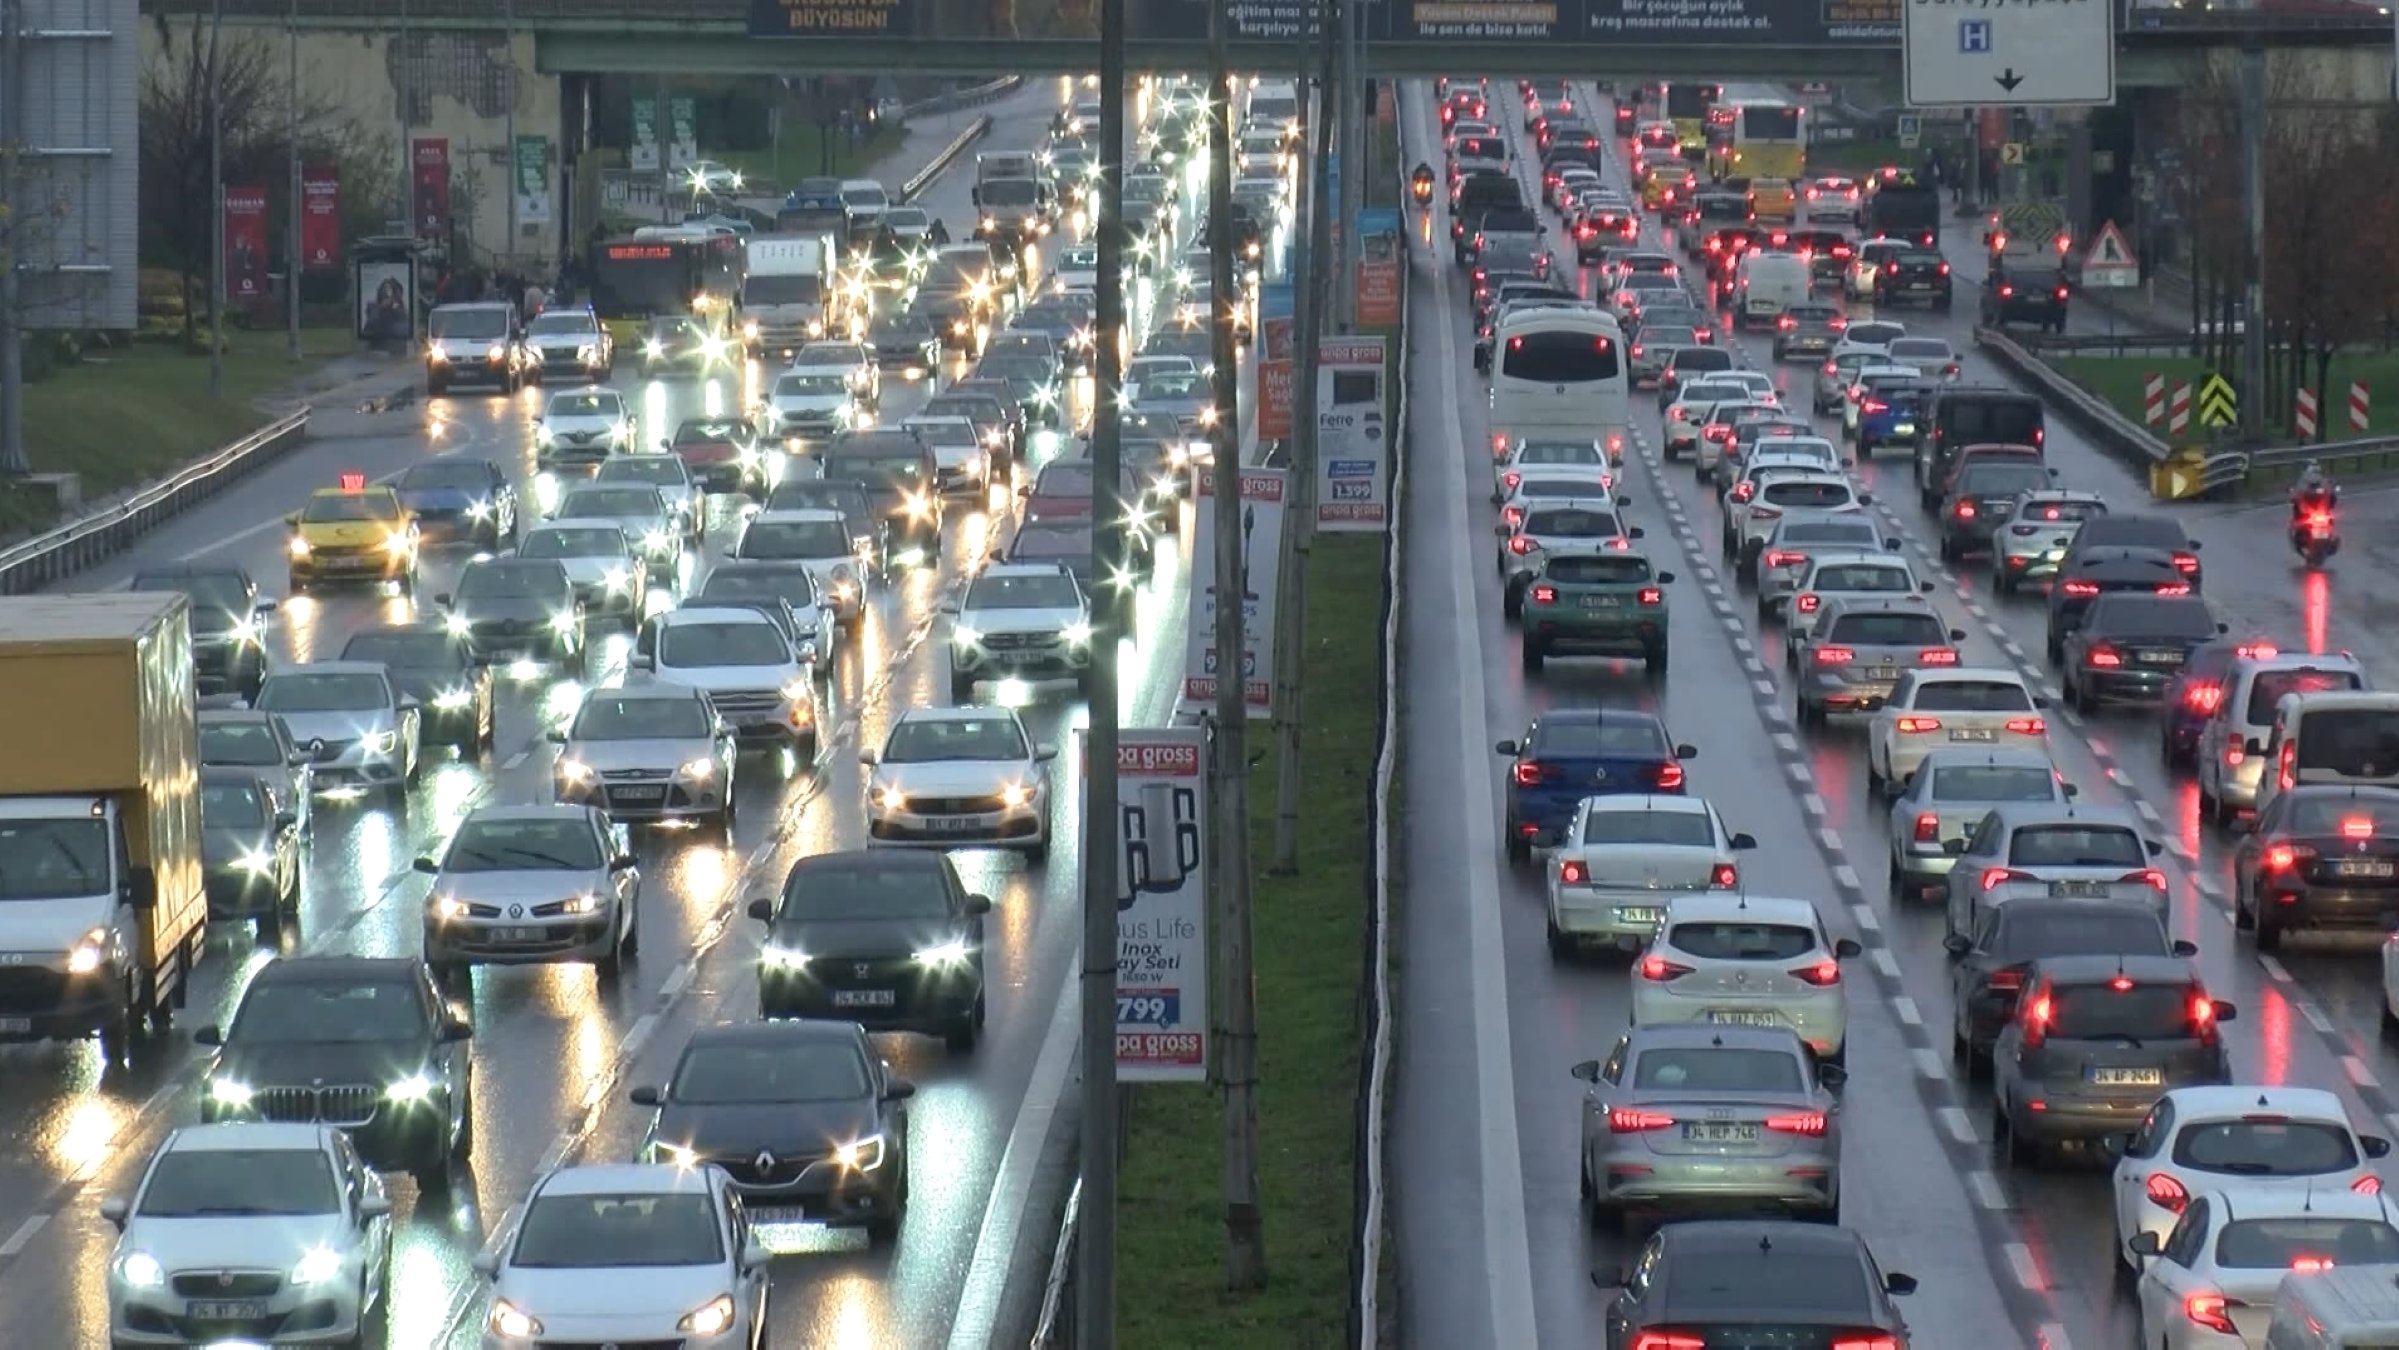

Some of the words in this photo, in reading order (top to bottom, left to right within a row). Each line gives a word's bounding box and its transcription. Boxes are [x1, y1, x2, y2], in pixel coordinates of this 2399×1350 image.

[1703, 14, 1751, 29] destek
[1243, 477, 1280, 495] gross
[1190, 679, 1217, 697] anp
[1142, 747, 1194, 769] gross
[1156, 917, 1196, 940] Life
[1122, 941, 1162, 957] Inox
[1117, 956, 1141, 975] ay
[1145, 952, 1181, 971] Seti
[1147, 1035, 1198, 1058] gross
